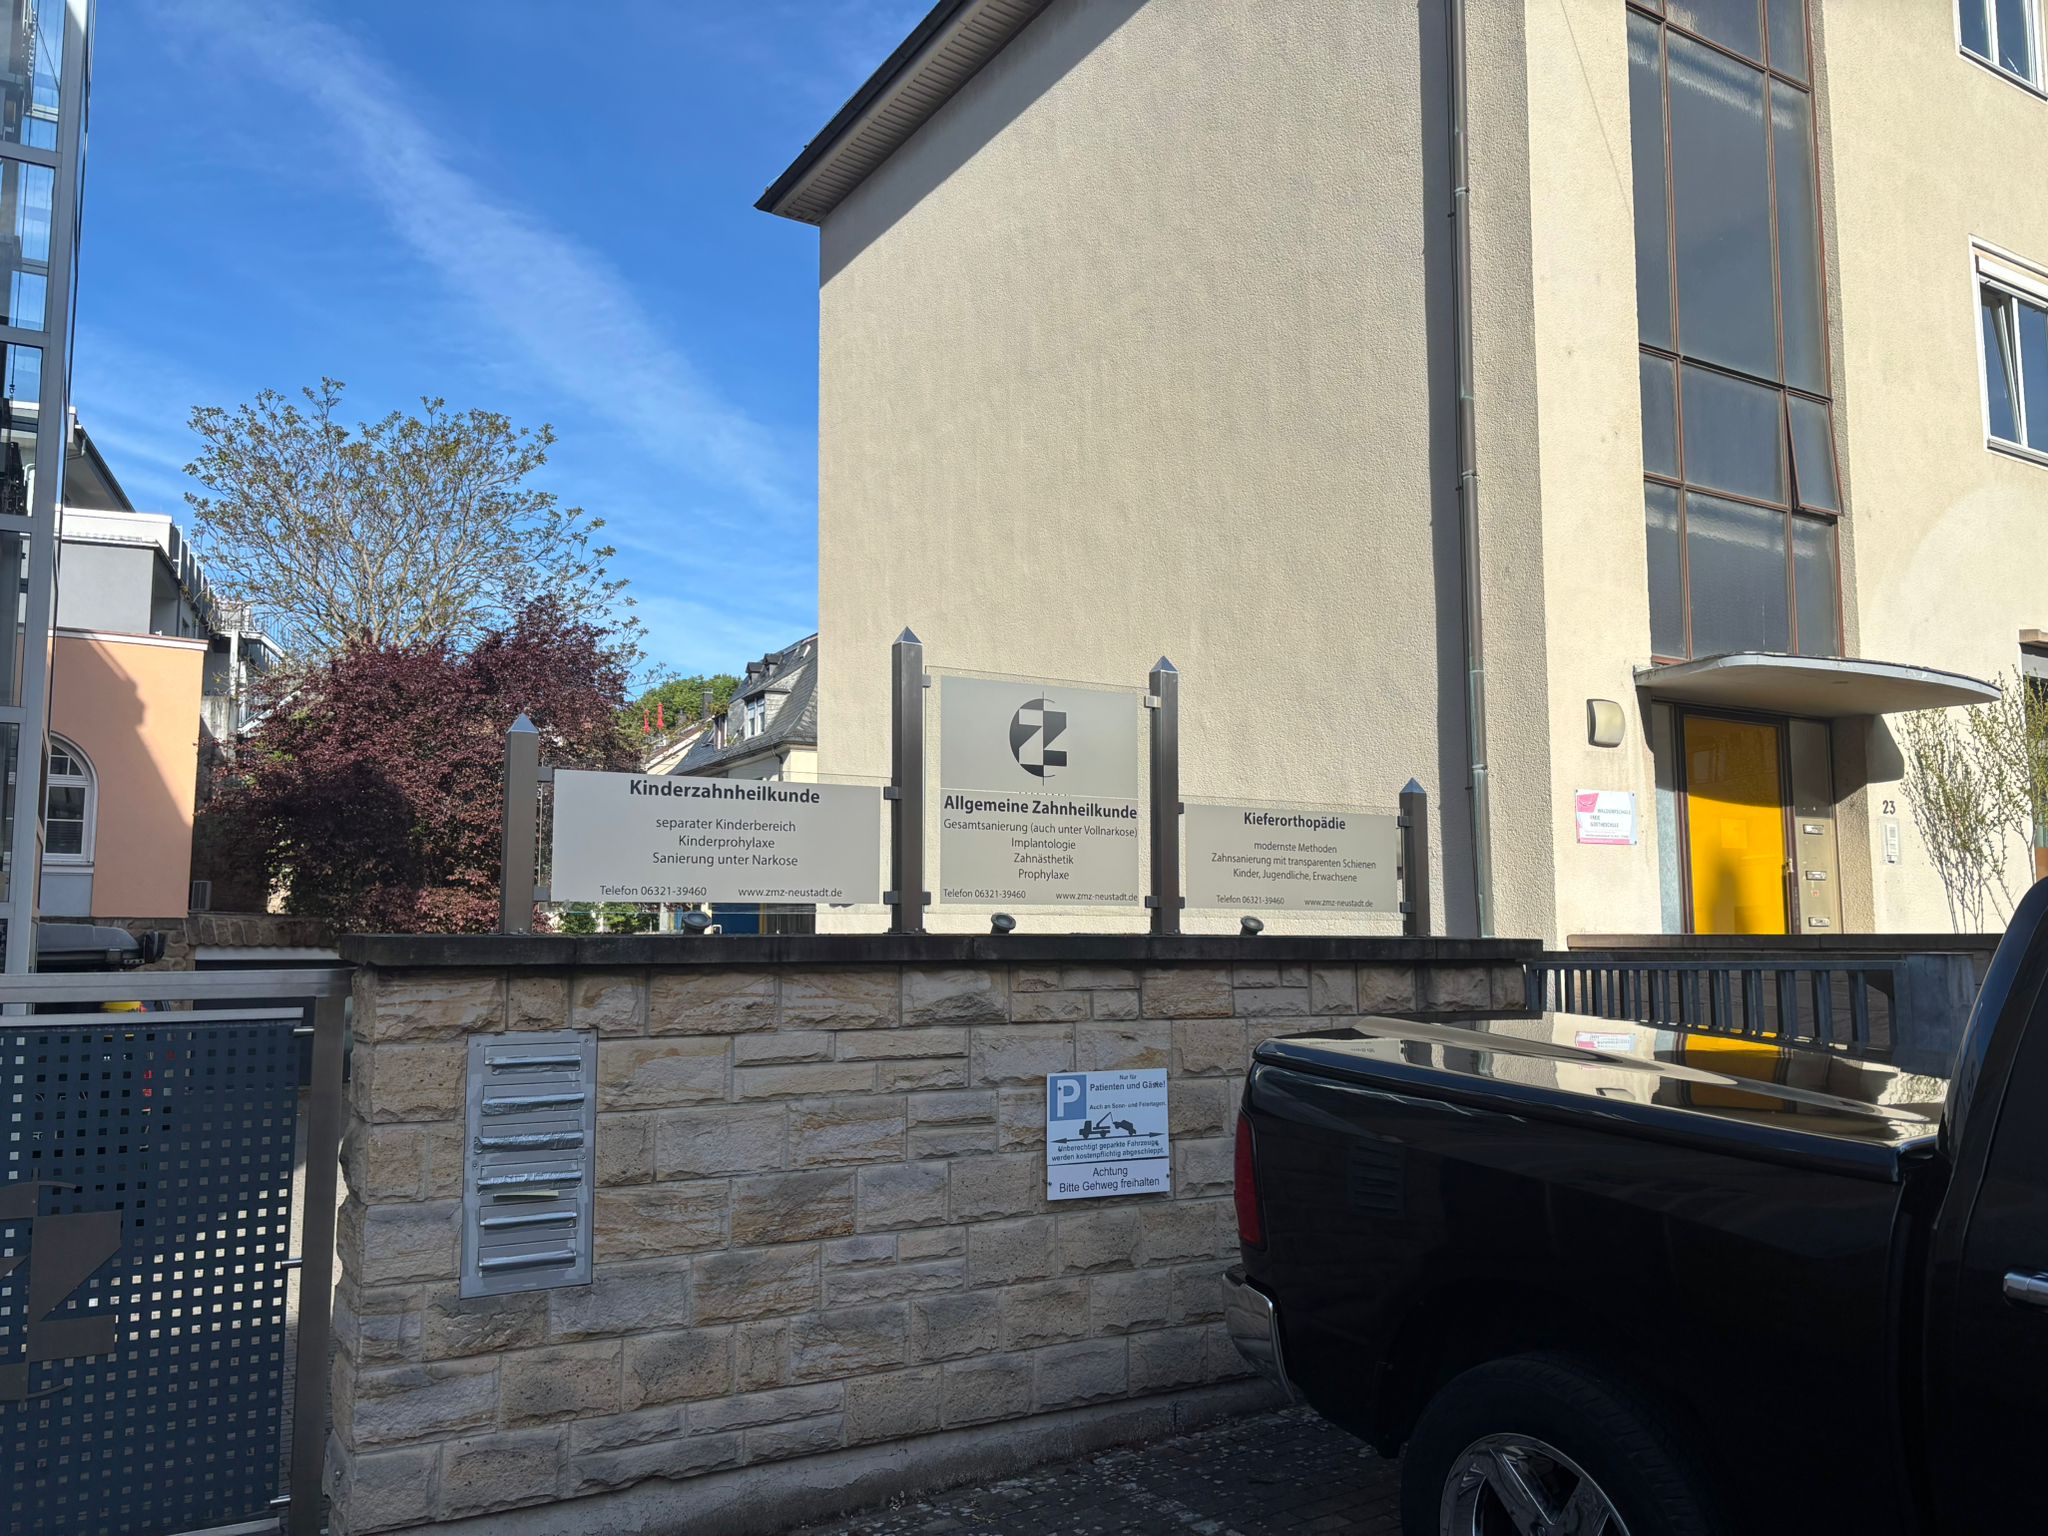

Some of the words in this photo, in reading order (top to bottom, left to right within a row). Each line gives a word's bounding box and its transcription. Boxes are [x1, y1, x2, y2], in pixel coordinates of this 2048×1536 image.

[630, 780, 820, 803] Kinderzahnheilkunde
[944, 796, 1028, 814] Allgemeine
[1032, 801, 1137, 819] Zahnheilkunde
[1883, 800, 1896, 814] 23
[656, 818, 712, 831] separater
[716, 819, 796, 832] Kinderbereich
[1244, 812, 1346, 831] Kieferorthopädie
[944, 819, 1028, 834] Gesamtsanierung
[1031, 822, 1055, 834] (auch
[1058, 825, 1082, 835] unter
[1085, 826, 1138, 838] Vollnarkose)
[679, 835, 775, 850] Kinderprohylaxe
[1011, 838, 1076, 851] Implantologie
[1254, 841, 1296, 852] modernste
[1298, 843, 1337, 853] Methoden
[653, 852, 714, 867] Sanierung
[718, 855, 749, 865] unter
[752, 855, 798, 866] Narkose
[1014, 853, 1074, 864] Zahnästhetik
[1273, 857, 1286, 865] mit
[1288, 858, 1341, 868] transparenten
[1343, 859, 1376, 869] Schienen
[1019, 869, 1069, 881] Prophylaxe
[1233, 869, 1261, 879] Kinder,
[1262, 870, 1311, 882] Jugendliche,
[1313, 872, 1357, 882] Erwachsene
[600, 885, 638, 896] Telefon
[641, 886, 707, 896] 06321-39460
[738, 887, 842, 898] www.zmz-neustadt.de
[944, 888, 973, 898] Telefon
[975, 890, 1026, 899] 06321-39460
[1056, 892, 1138, 901] www.zmz-neustadt.de
[1217, 895, 1241, 904] Telefon
[1090, 1082, 1125, 1091] Patienten
[1100, 1142, 1125, 1150] geparkte
[1076, 1151, 1121, 1159] kostenpflichtig
[1093, 1167, 1128, 1177] Achtung
[1059, 1183, 1080, 1193] Bitte
[1082, 1181, 1118, 1191] Gehweg
[1121, 1178, 1159, 1188] freihalten
